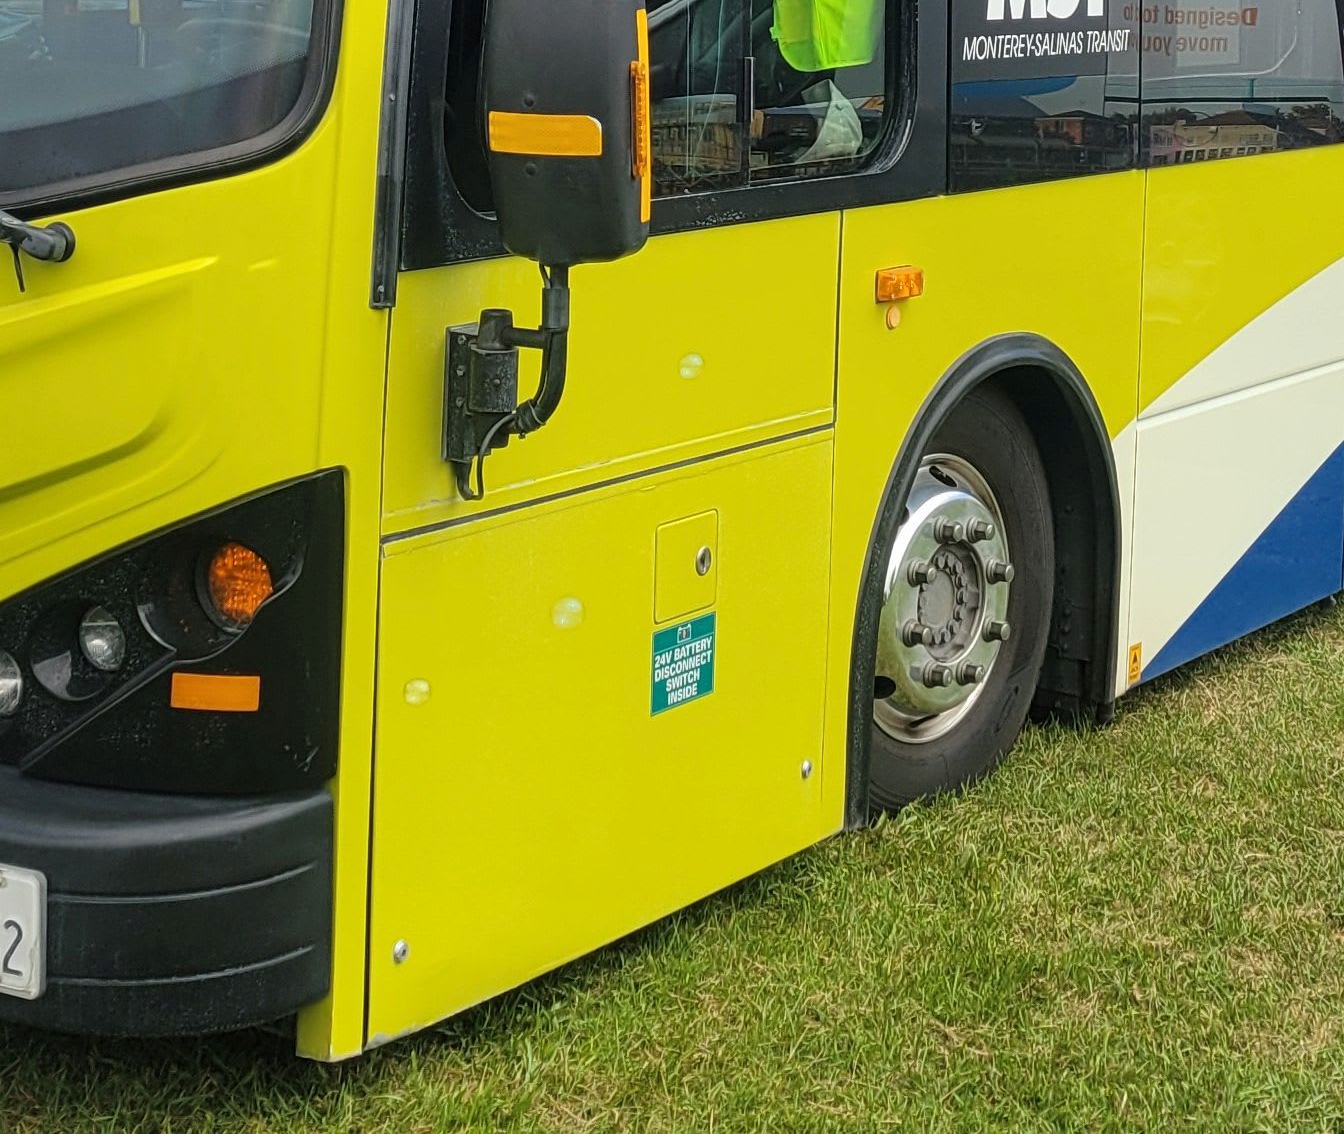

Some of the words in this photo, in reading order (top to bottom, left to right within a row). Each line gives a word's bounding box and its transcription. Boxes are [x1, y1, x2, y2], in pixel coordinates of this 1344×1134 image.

[962, 31, 1084, 61] MONTEREY-SALINAS
[1086, 29, 1131, 53] TRANSIT
[655, 650, 672, 668] 24V
[674, 636, 712, 661] BATTERY
[655, 650, 712, 682] DISCONNECT
[666, 668, 700, 692] SWITCH
[667, 682, 698, 705] INSIDE
